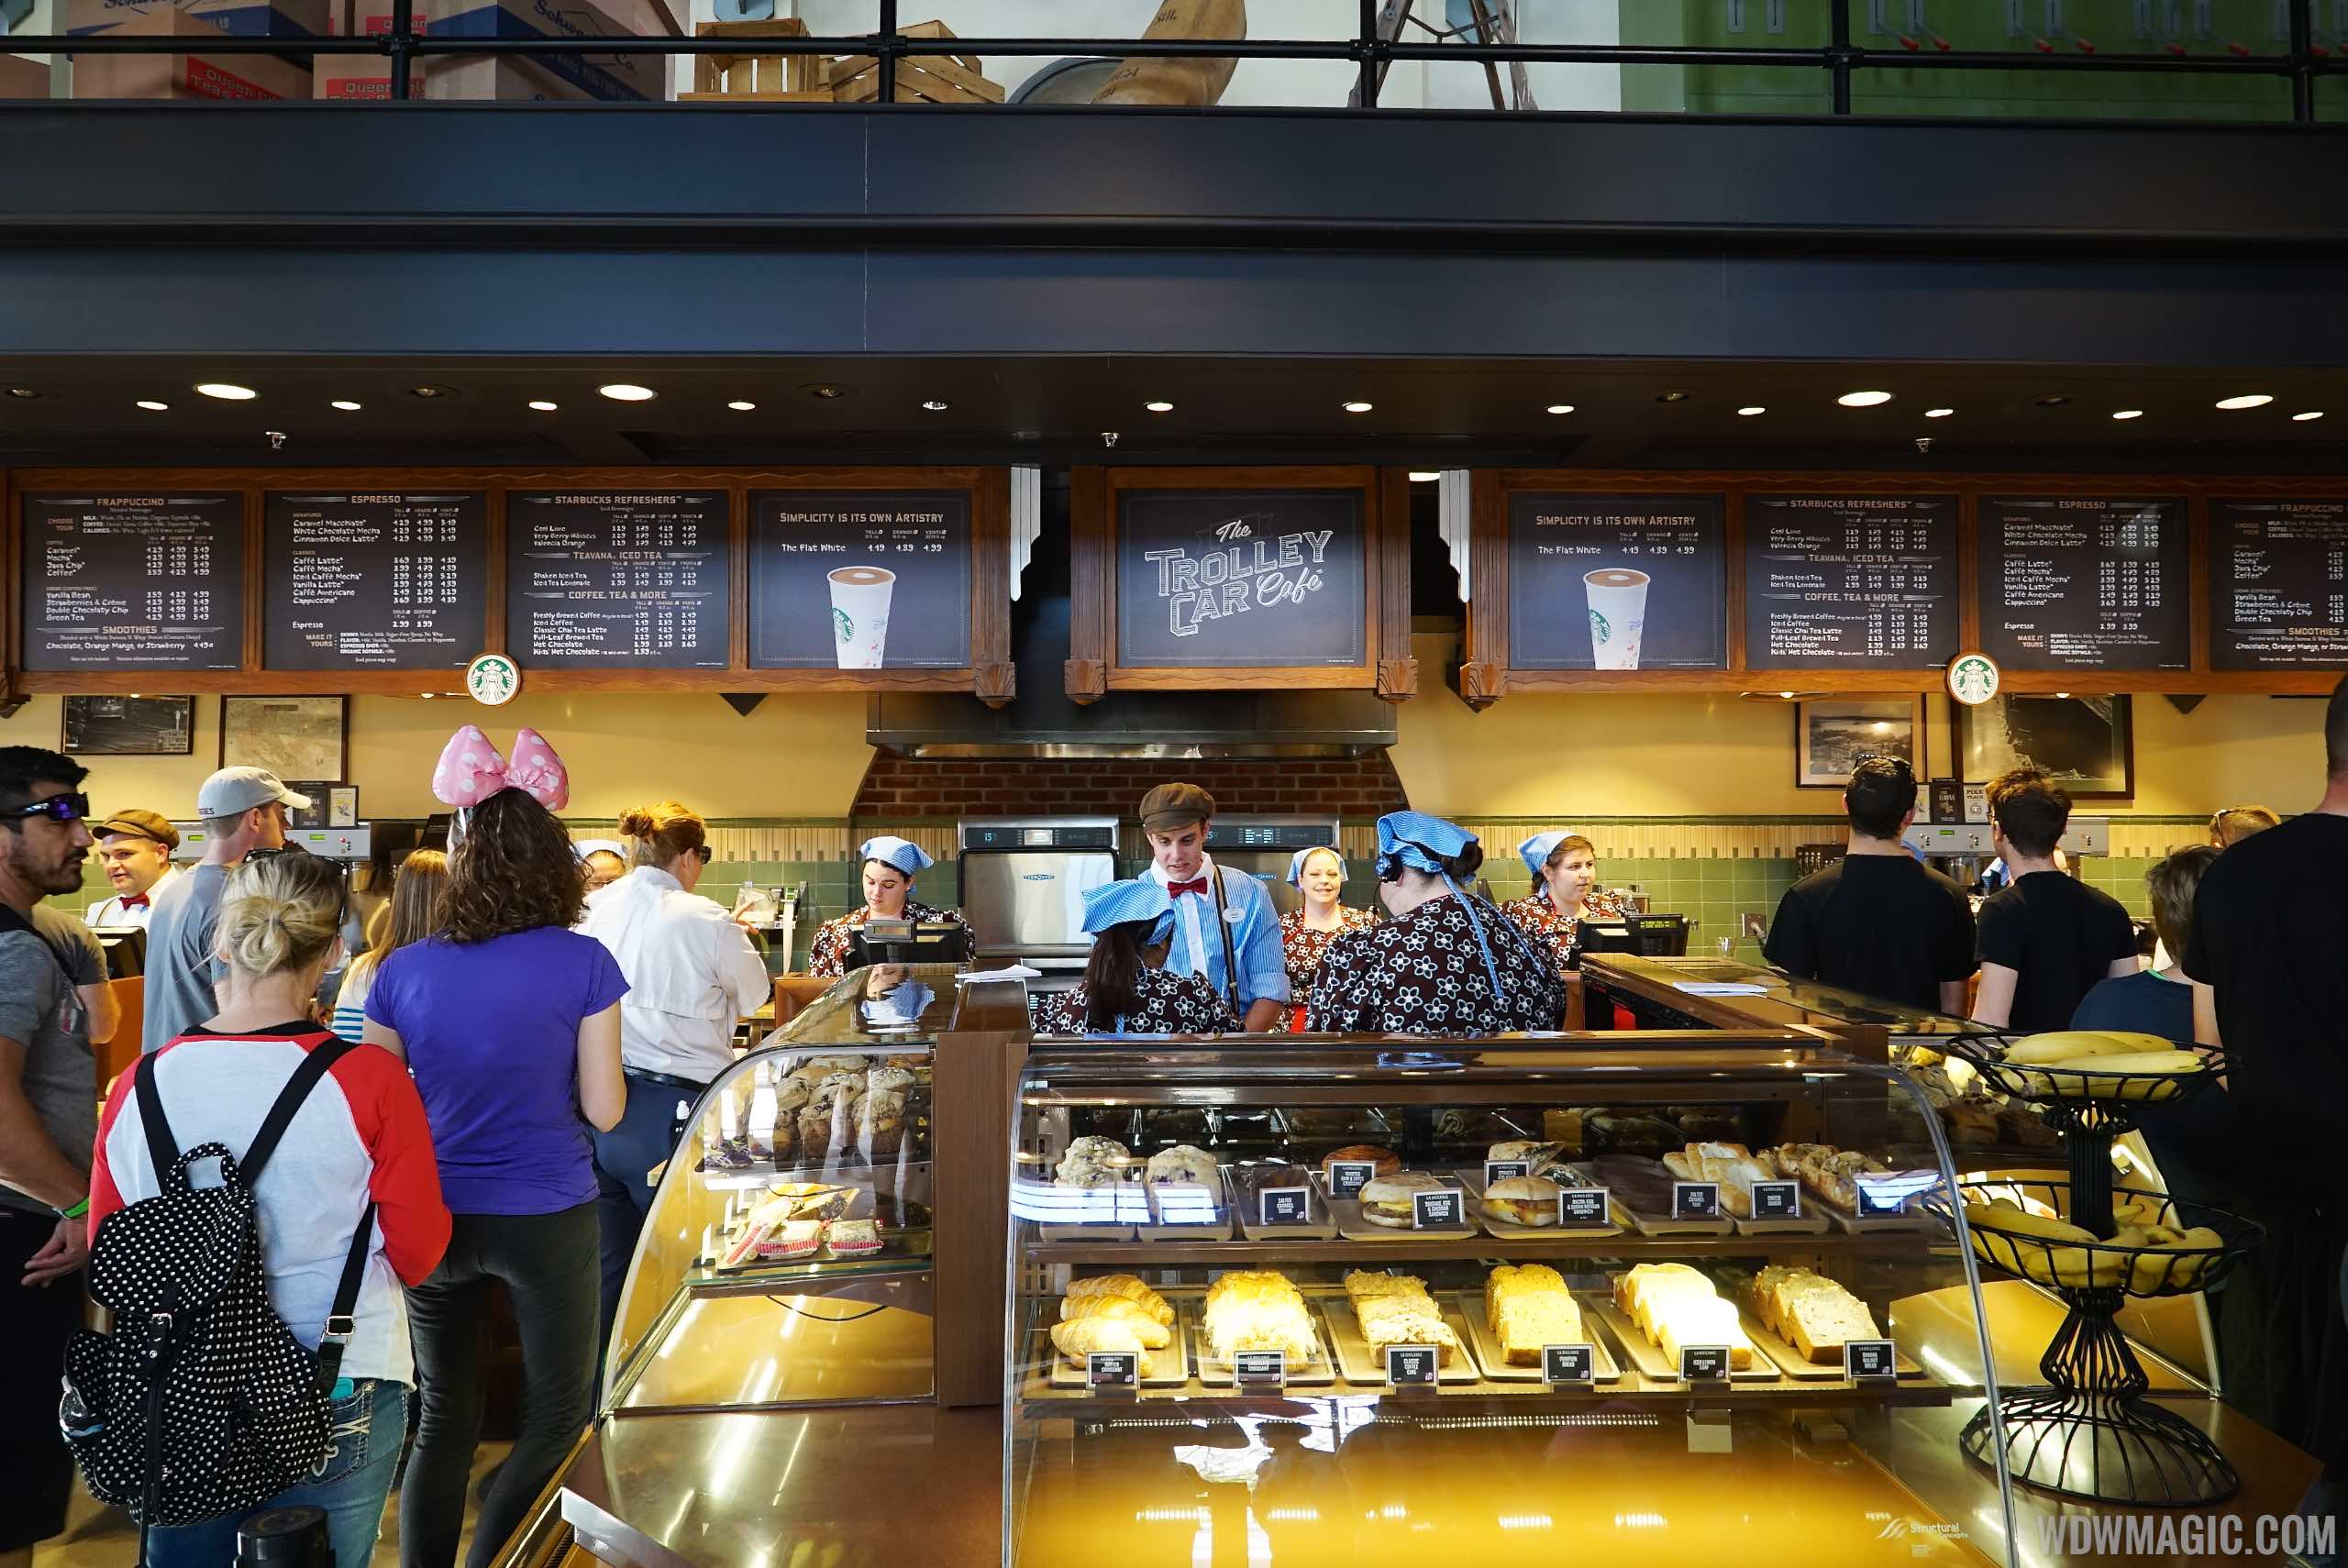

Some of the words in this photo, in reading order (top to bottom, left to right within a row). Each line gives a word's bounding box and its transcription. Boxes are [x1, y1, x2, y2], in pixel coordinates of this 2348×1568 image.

[383, 18, 426, 29] Qen
[2281, 504, 2343, 513] FRAPPUCCINO
[1216, 520, 1252, 543] The
[1145, 530, 1334, 597] TROLLEY
[1169, 580, 1251, 637] CAR
[85, 643, 109, 651] Orange
[1911, 1523, 1958, 1533] Structural
